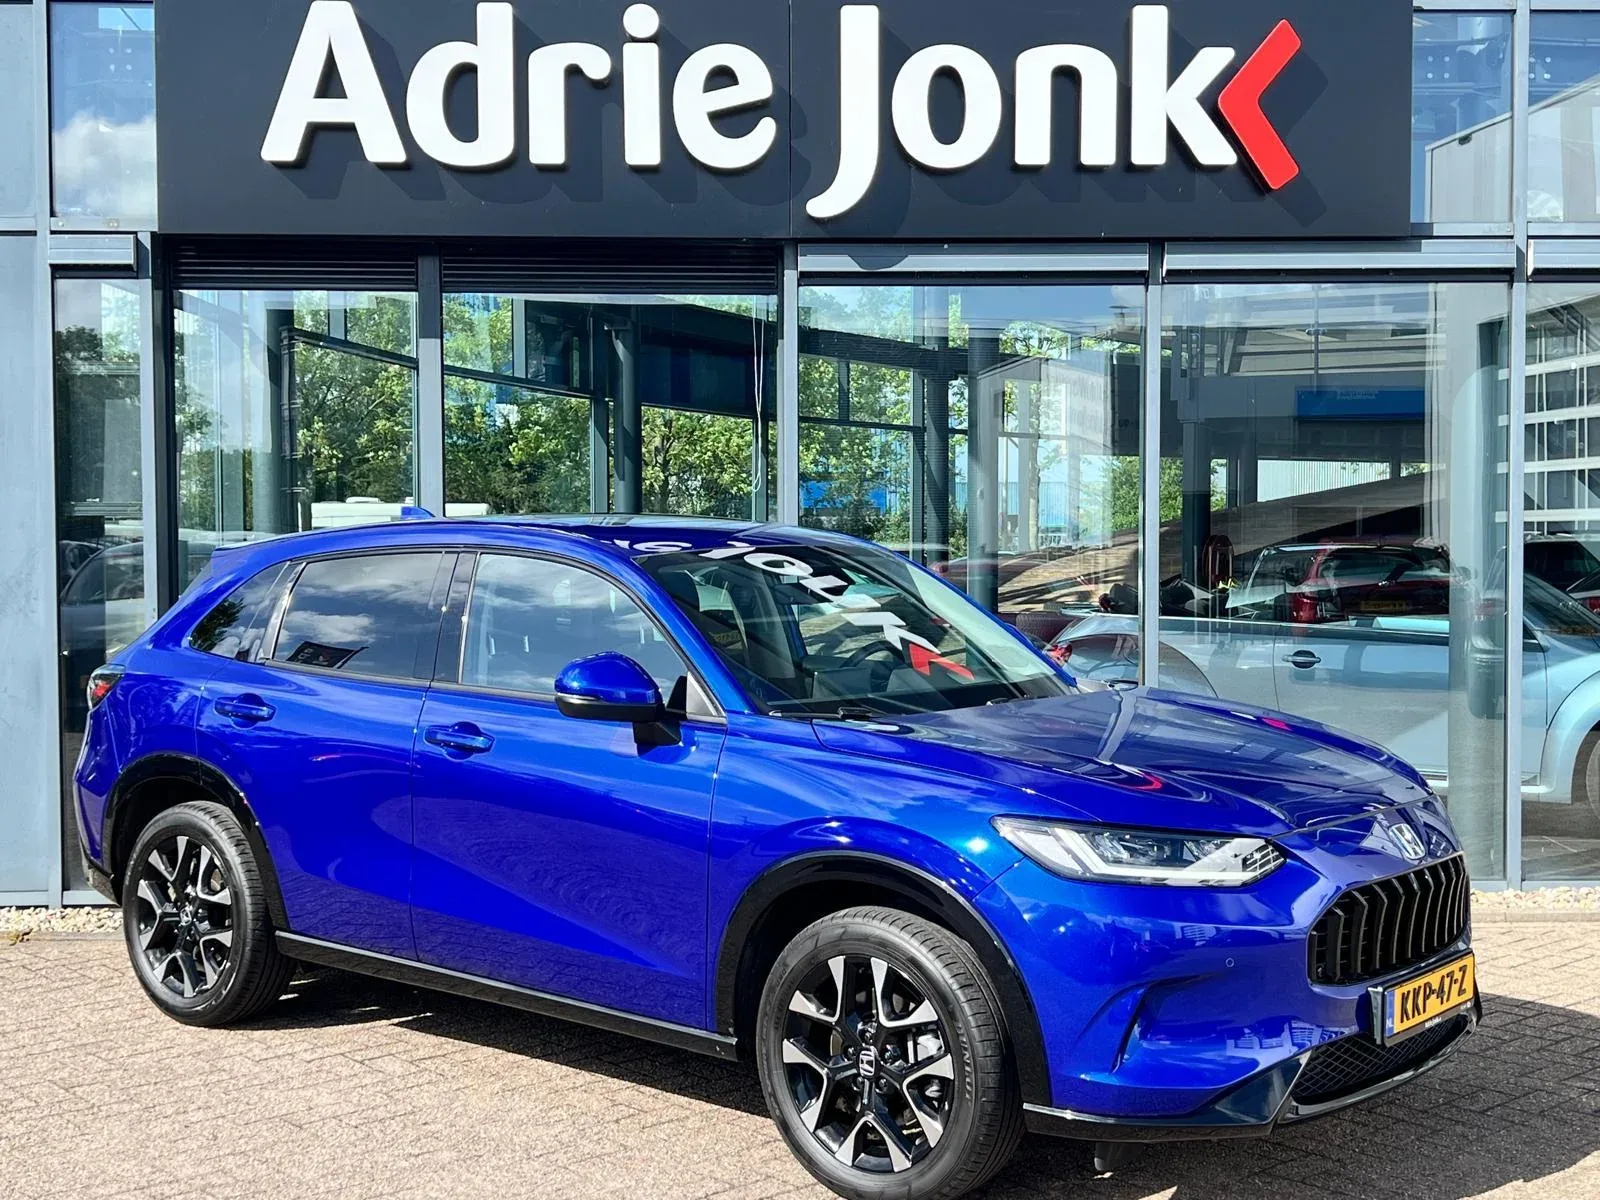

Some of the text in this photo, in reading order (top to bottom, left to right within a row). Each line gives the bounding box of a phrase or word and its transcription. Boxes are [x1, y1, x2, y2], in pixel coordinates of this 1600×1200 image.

[261, 0, 1237, 218] Adrie Jonk
[1400, 964, 1468, 1023] KKP-47-Z
